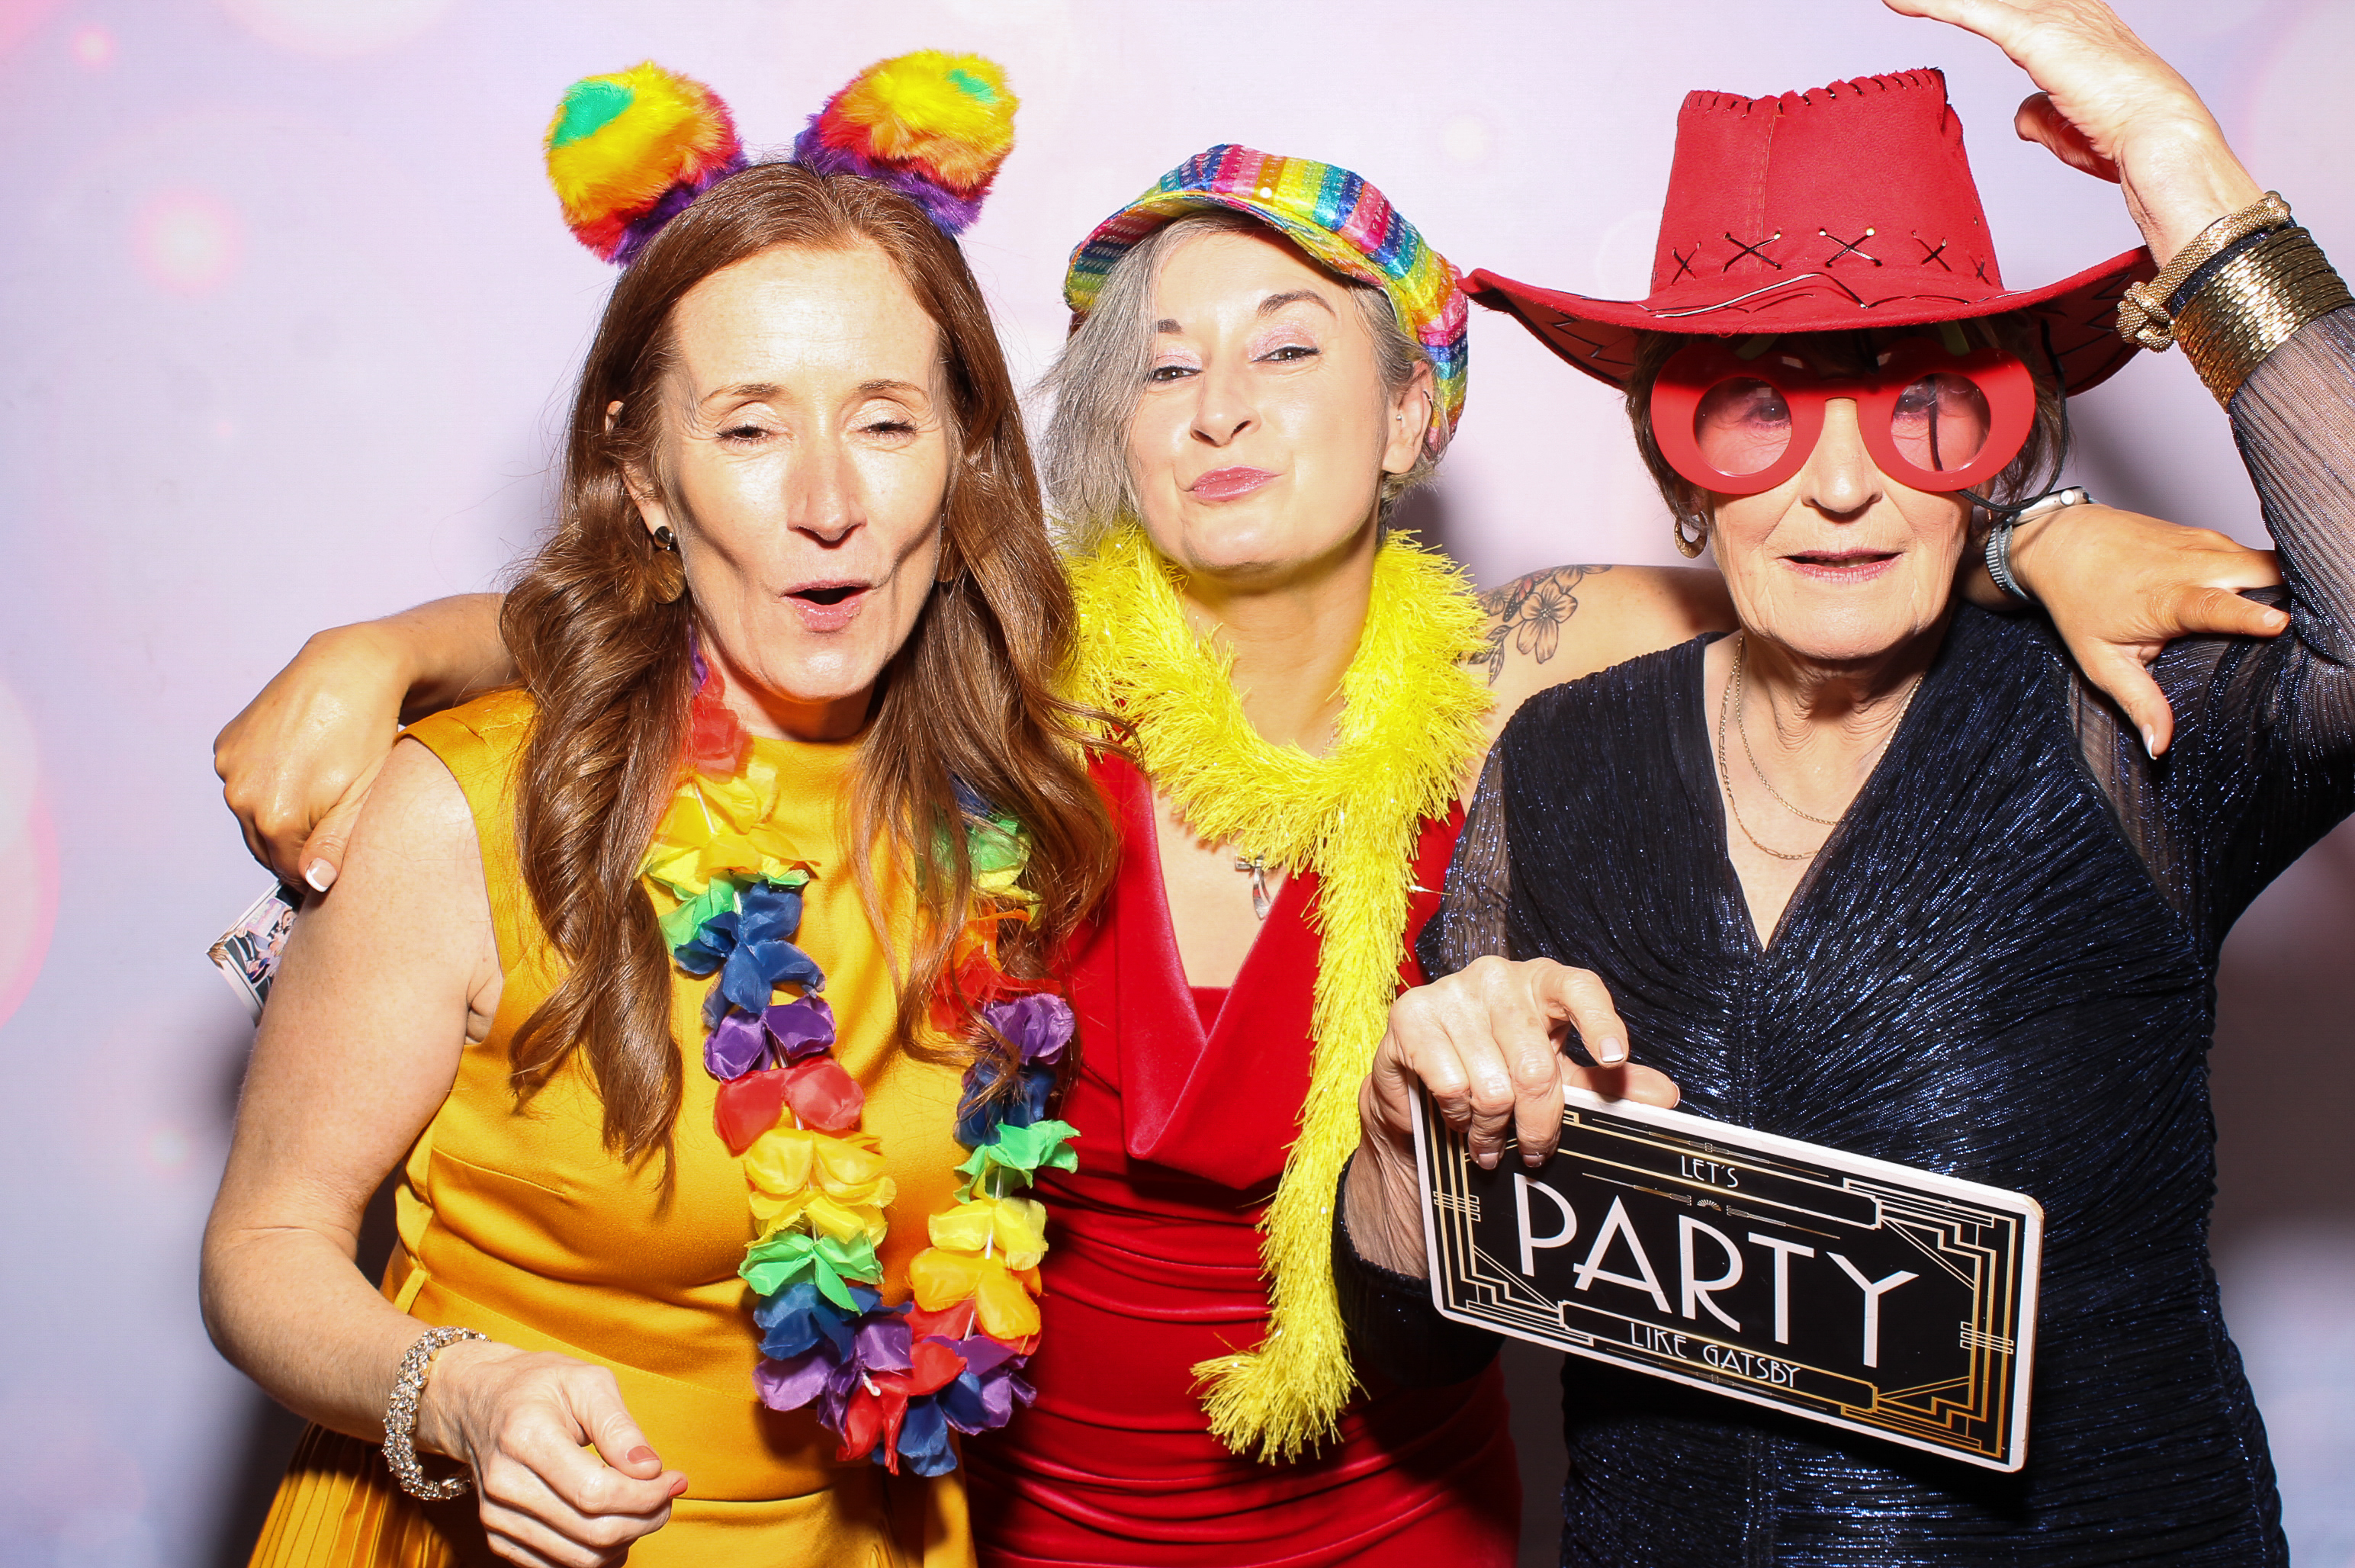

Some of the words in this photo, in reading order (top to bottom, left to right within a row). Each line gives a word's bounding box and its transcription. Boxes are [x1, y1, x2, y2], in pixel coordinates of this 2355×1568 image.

[1680, 1154, 1740, 1189] LET'S
[1514, 1172, 1920, 1368] PARTY
[1630, 1322, 1688, 1359] LIKE
[1702, 1345, 1801, 1388] GATSBY
